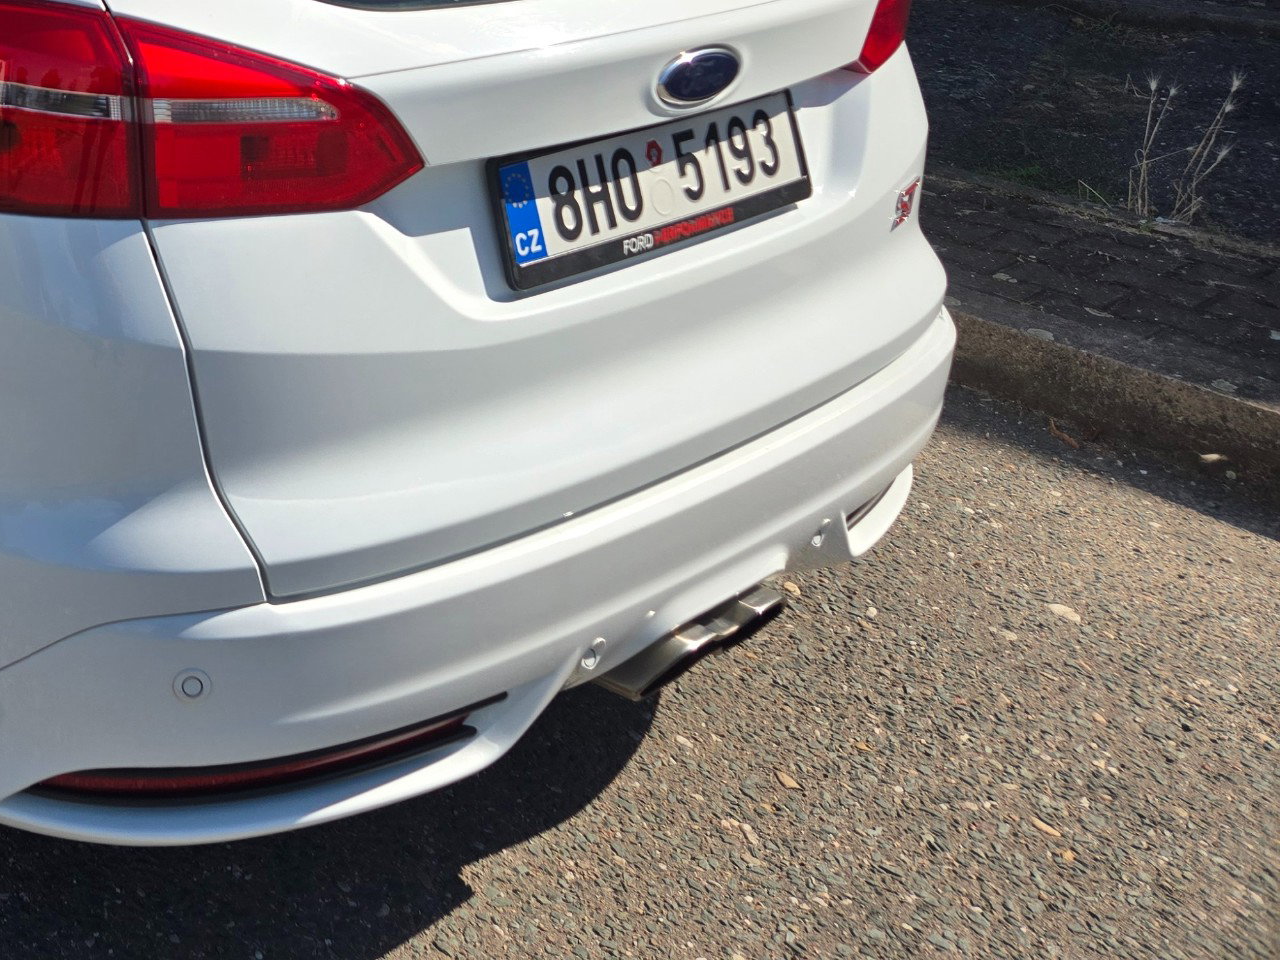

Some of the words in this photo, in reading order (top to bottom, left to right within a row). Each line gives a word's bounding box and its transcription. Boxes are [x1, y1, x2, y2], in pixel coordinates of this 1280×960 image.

[672, 109, 779, 200] 5193
[515, 227, 543, 257] CZ
[623, 232, 654, 256] FORD
